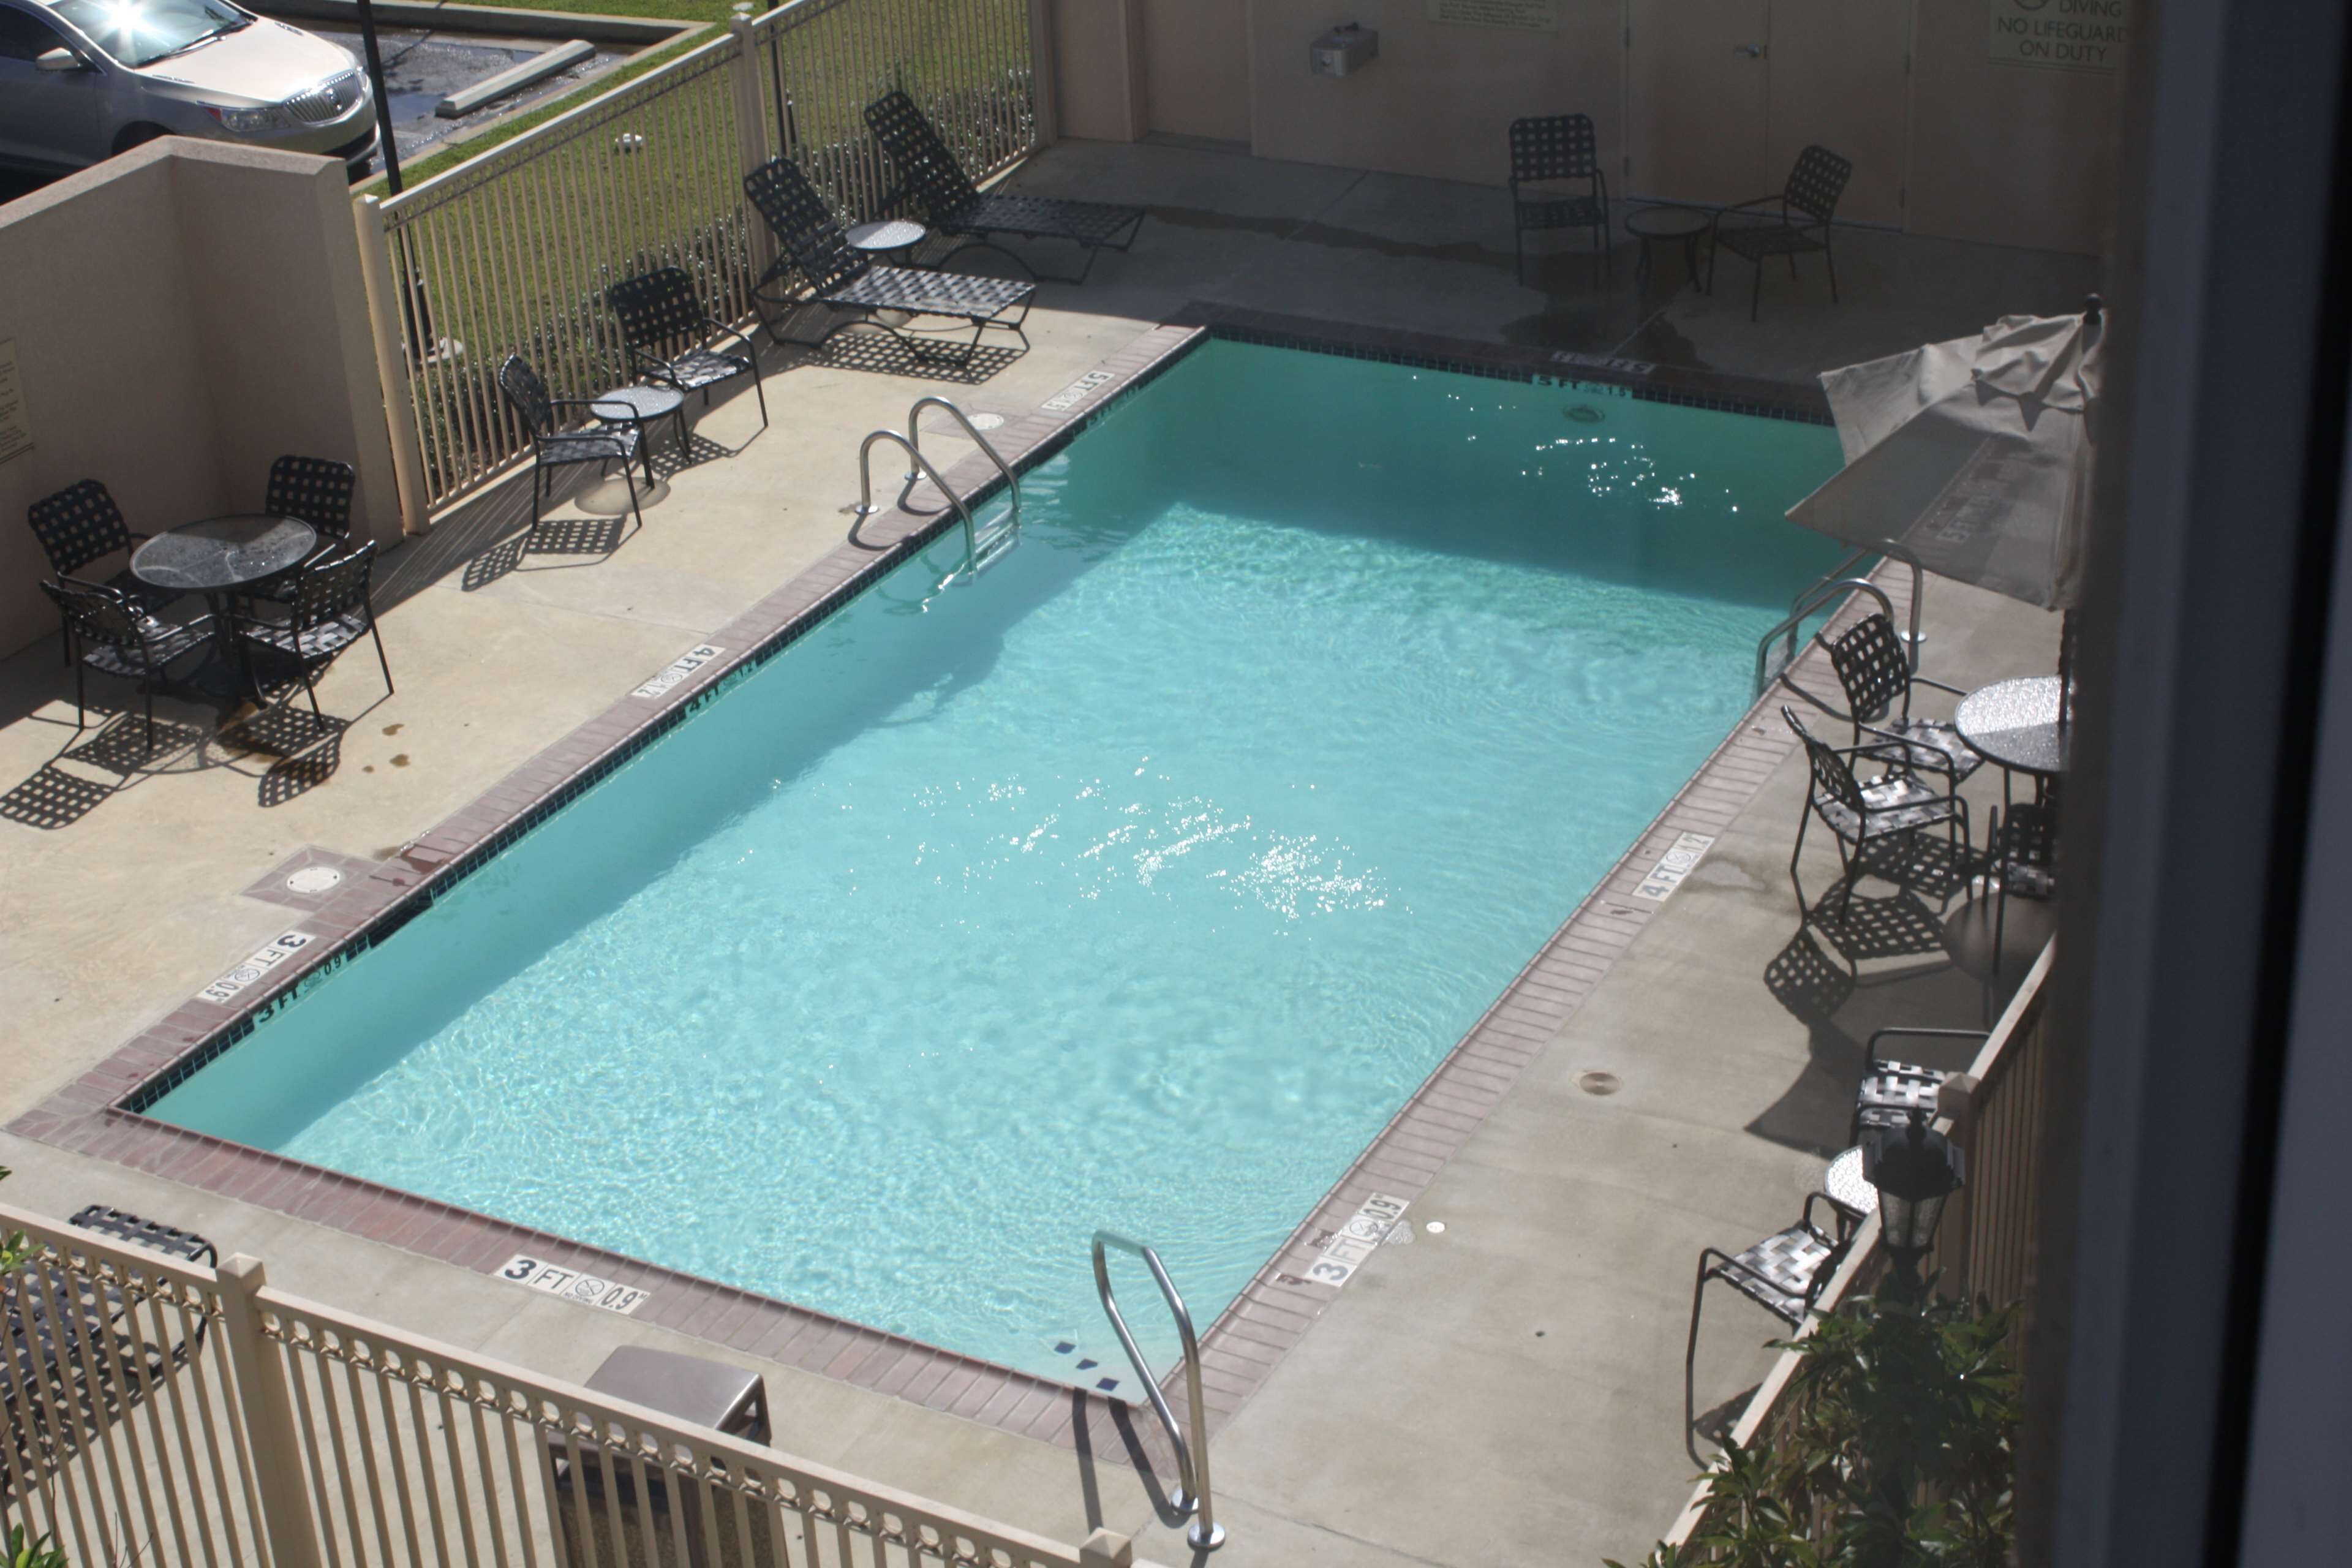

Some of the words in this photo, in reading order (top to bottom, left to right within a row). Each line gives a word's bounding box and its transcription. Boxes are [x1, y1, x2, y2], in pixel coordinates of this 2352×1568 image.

[1997, 16, 2028, 35] NO
[2019, 39, 2049, 58] ON
[2056, 42, 2107, 63] DUTY
[692, 647, 715, 657] 4
[673, 657, 703, 672] FT
[1649, 864, 1687, 883] FT
[1641, 885, 1670, 897] 4
[277, 934, 307, 948] 3
[254, 949, 286, 967] FT
[258, 1004, 275, 1023] 3
[504, 1259, 537, 1280] 3
[533, 1268, 575, 1289] FT
[1313, 1262, 1349, 1281] 3
